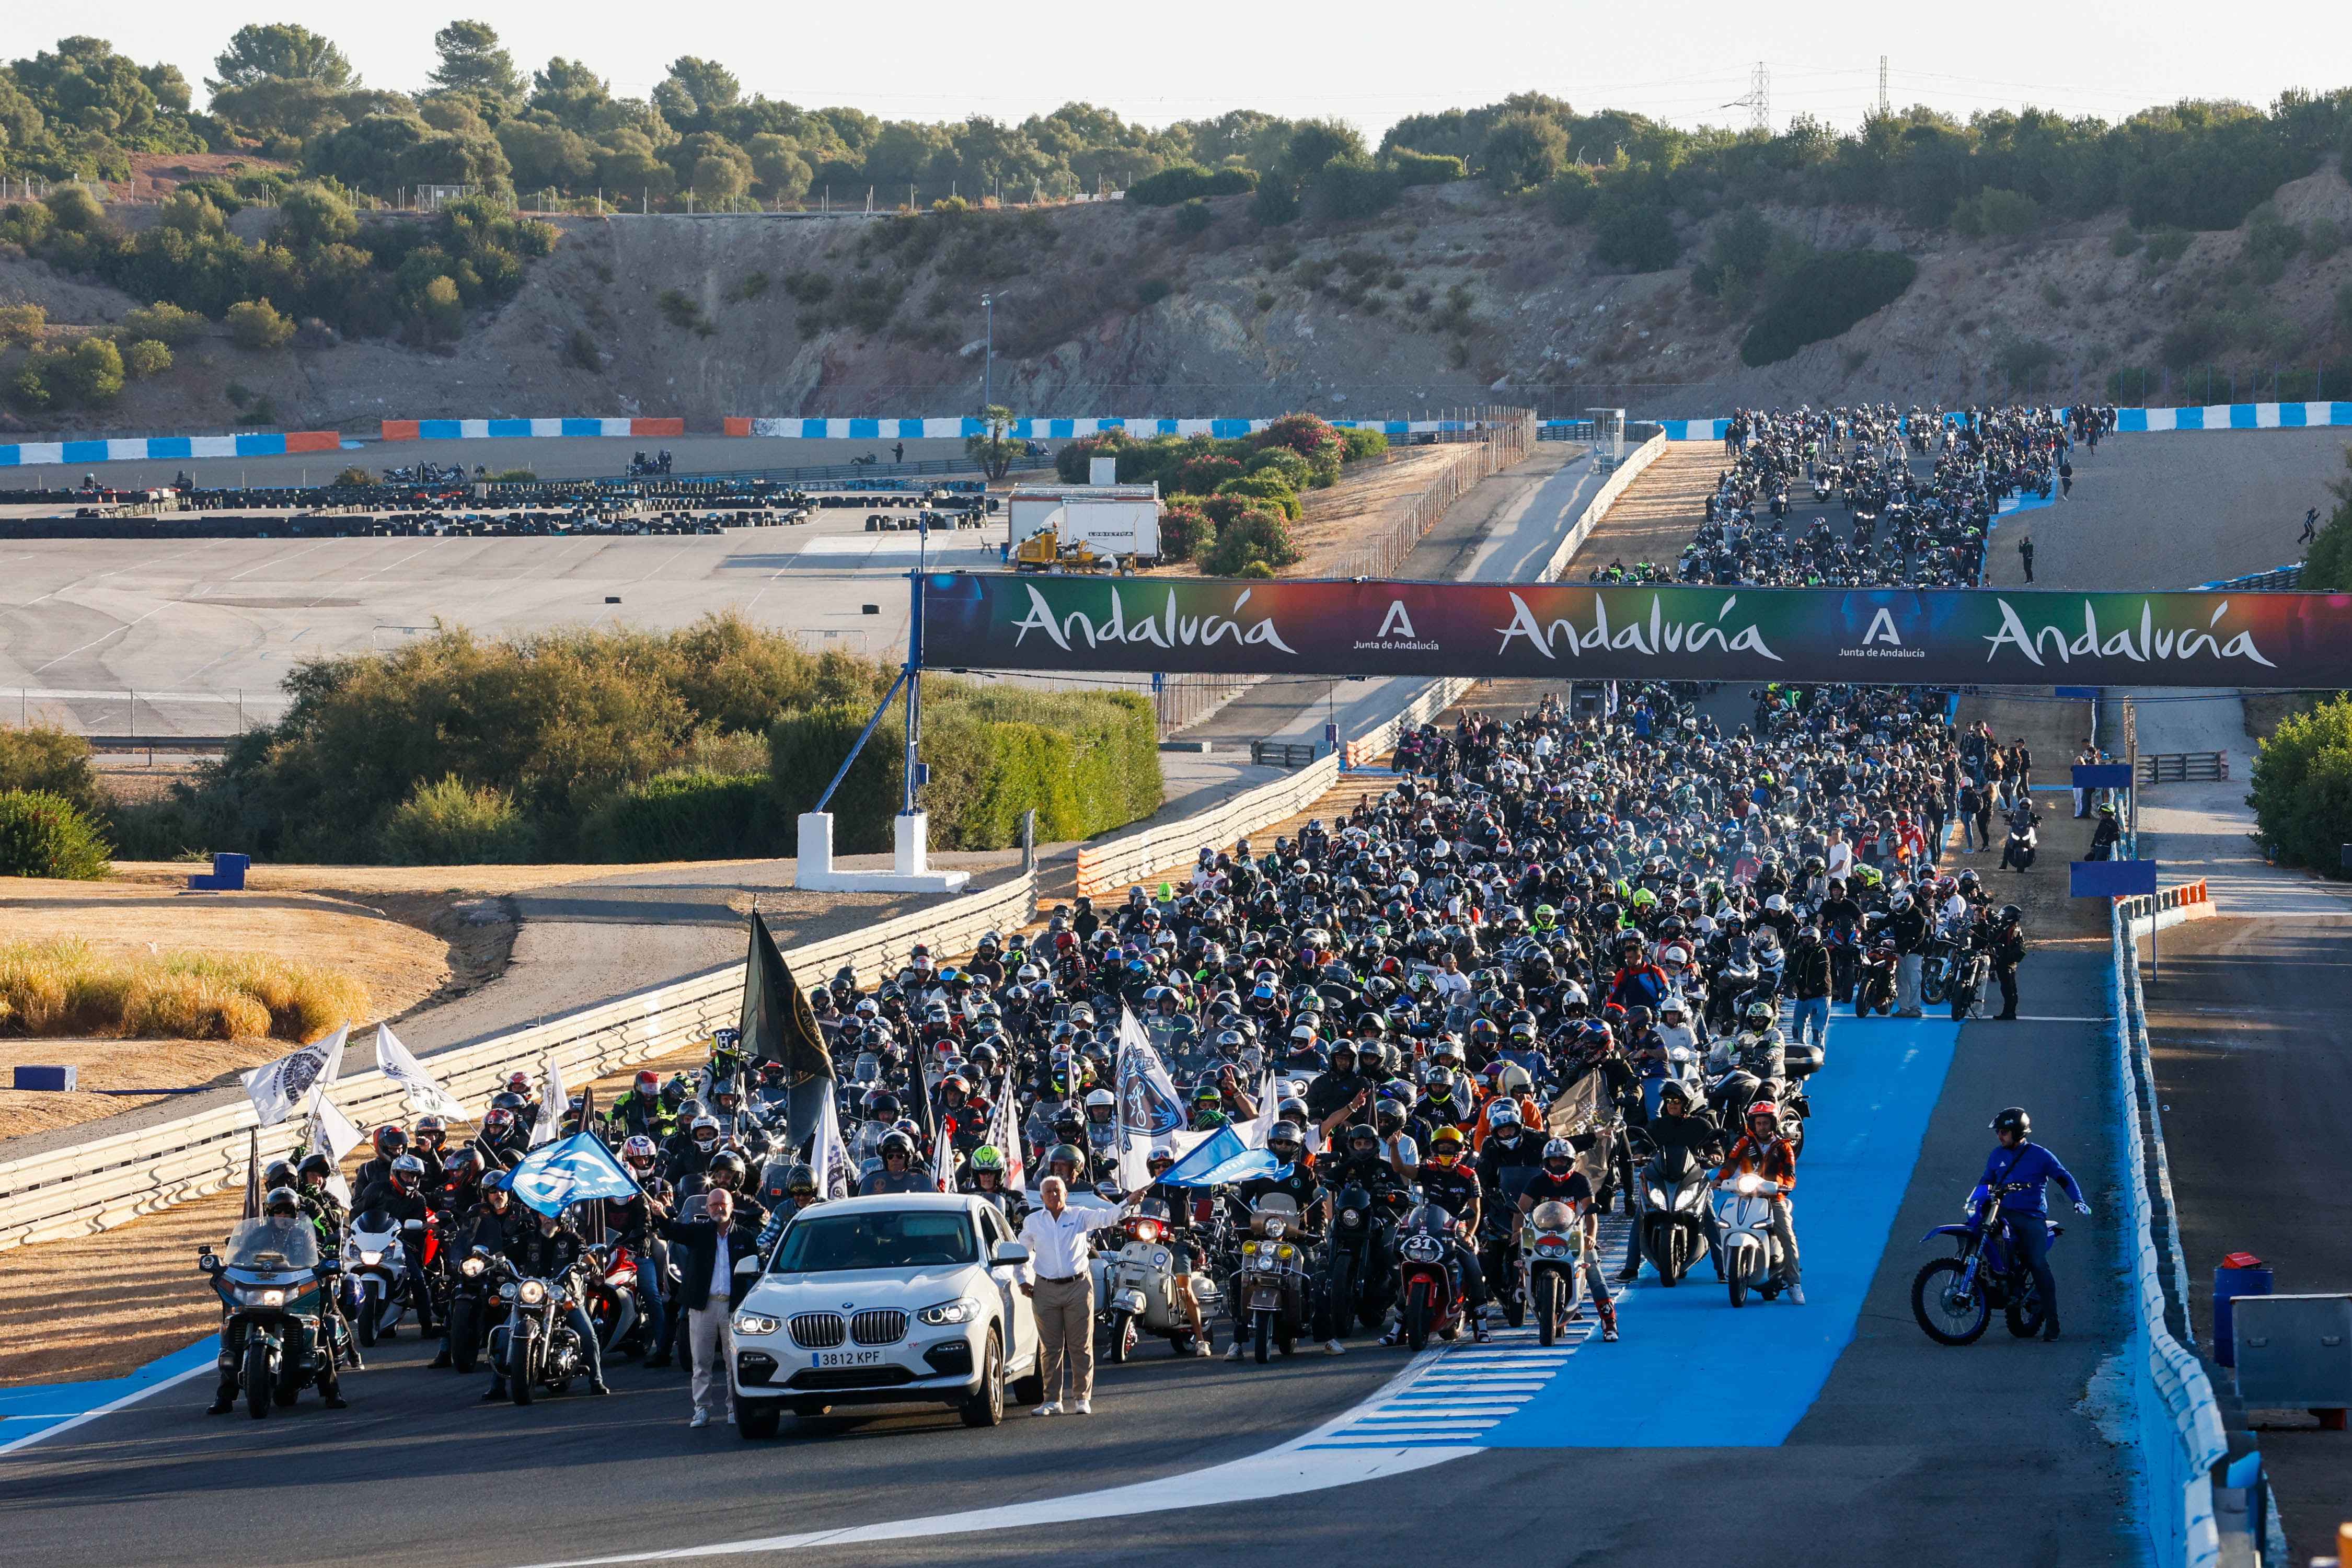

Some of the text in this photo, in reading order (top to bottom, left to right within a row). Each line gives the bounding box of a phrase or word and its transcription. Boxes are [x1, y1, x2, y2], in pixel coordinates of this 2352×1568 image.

[1011, 583, 1298, 654] Andalucía
[1494, 591, 1784, 662] Andalucía
[1353, 640, 1439, 650] Junta de Andalucía
[1982, 598, 2277, 668] Andalucía
[1838, 648, 1925, 658] Junta de Andalucía
[801, 1008, 821, 1042] CAMPO
[1409, 1237, 1432, 1250] 31
[822, 1351, 880, 1365] 3812 KPF
